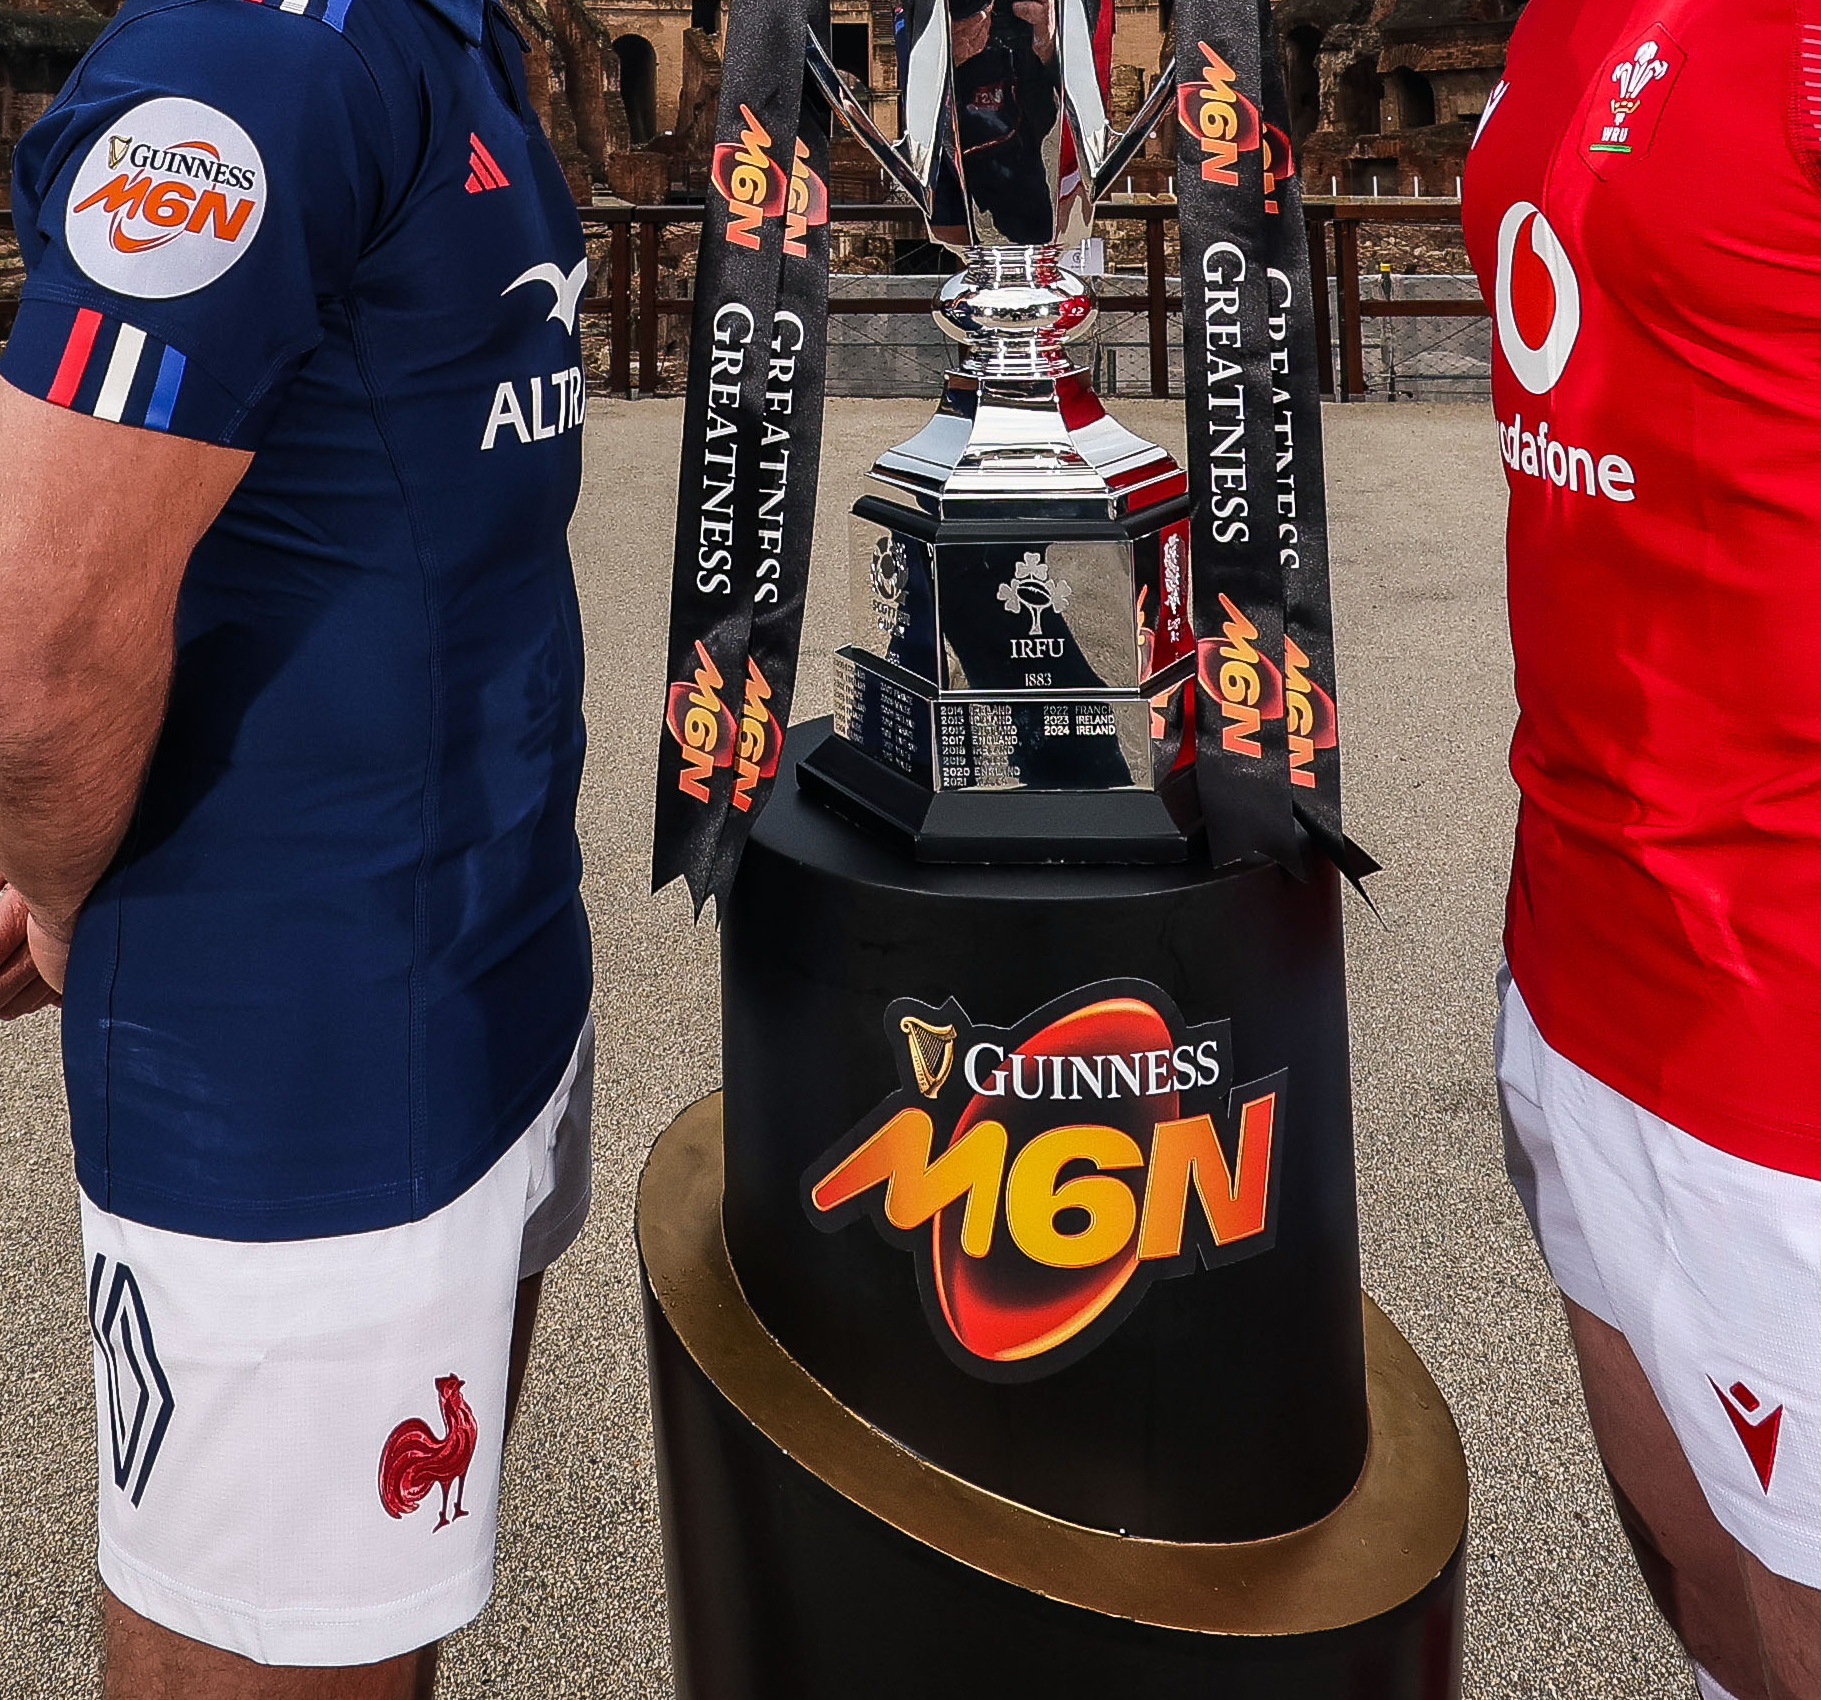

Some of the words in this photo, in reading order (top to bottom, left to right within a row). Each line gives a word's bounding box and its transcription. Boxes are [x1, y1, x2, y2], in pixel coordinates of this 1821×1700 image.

[1601, 126, 1629, 143] WRU
[130, 143, 256, 191] GUINNESS
[1203, 241, 1250, 543] GREATNESS
[480, 366, 586, 451] ALTR
[696, 302, 755, 595] GREATNESS
[754, 310, 805, 604] GREATNESS
[1496, 413, 1636, 502] odafone
[1010, 638, 1066, 659] IRFU
[1025, 672, 1052, 687] 1883
[940, 706, 964, 716] 2014
[1043, 705, 1069, 715] 2022
[1044, 715, 1070, 725] 2023
[1075, 715, 1115, 725] IRELAND
[1044, 725, 1070, 735] 2024
[1076, 725, 1116, 735] IRELAND
[941, 735, 965, 745] 2017
[972, 735, 1018, 745] ENGLAND
[942, 767, 970, 777] 2020
[943, 778, 967, 787] 2021
[964, 1038, 1221, 1101] GUINNESS
